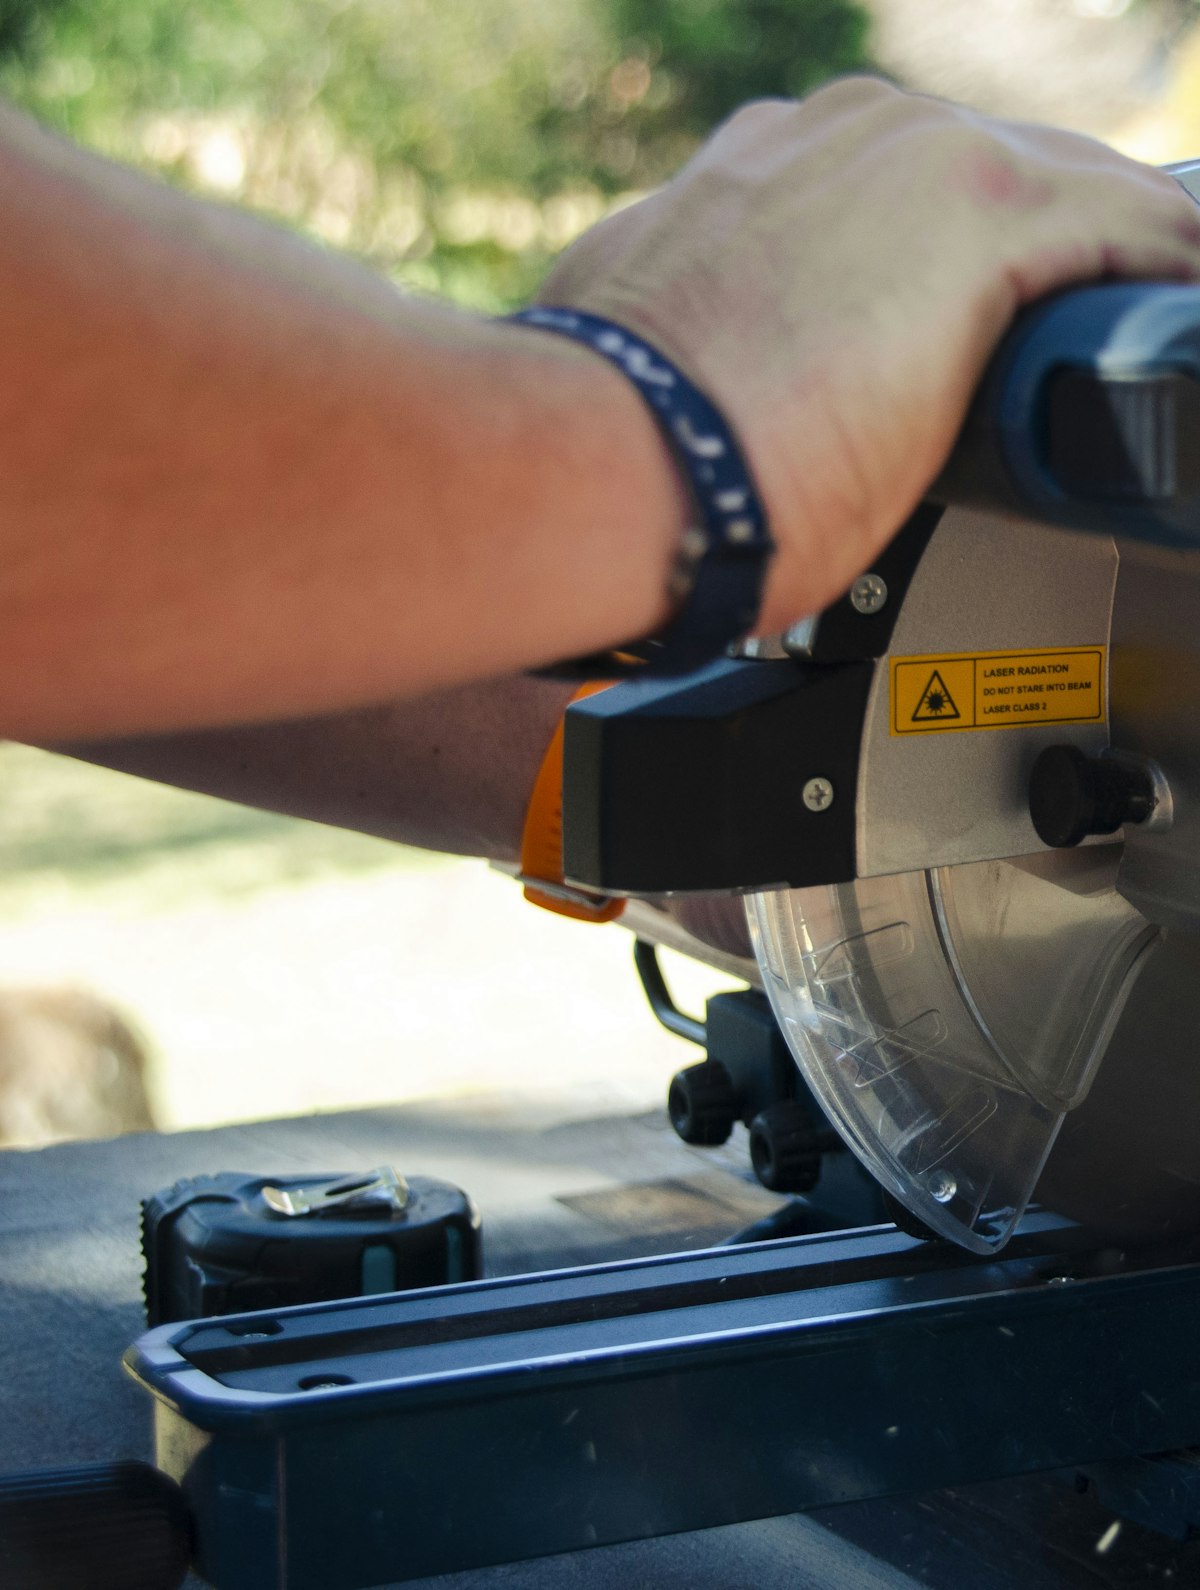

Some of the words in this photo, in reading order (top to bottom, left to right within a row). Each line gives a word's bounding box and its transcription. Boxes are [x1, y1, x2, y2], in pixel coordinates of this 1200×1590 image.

[983, 667, 1015, 678] LASER
[1017, 664, 1069, 677] RADIATION
[983, 687, 996, 696] DO
[998, 686, 1015, 695] NOT
[1017, 684, 1044, 694] STARE
[1046, 683, 1066, 692] INTO
[1068, 681, 1092, 691] BEAM
[983, 704, 1011, 714] LASER
[1013, 703, 1040, 713] CLASS
[1042, 703, 1047, 711] 2
